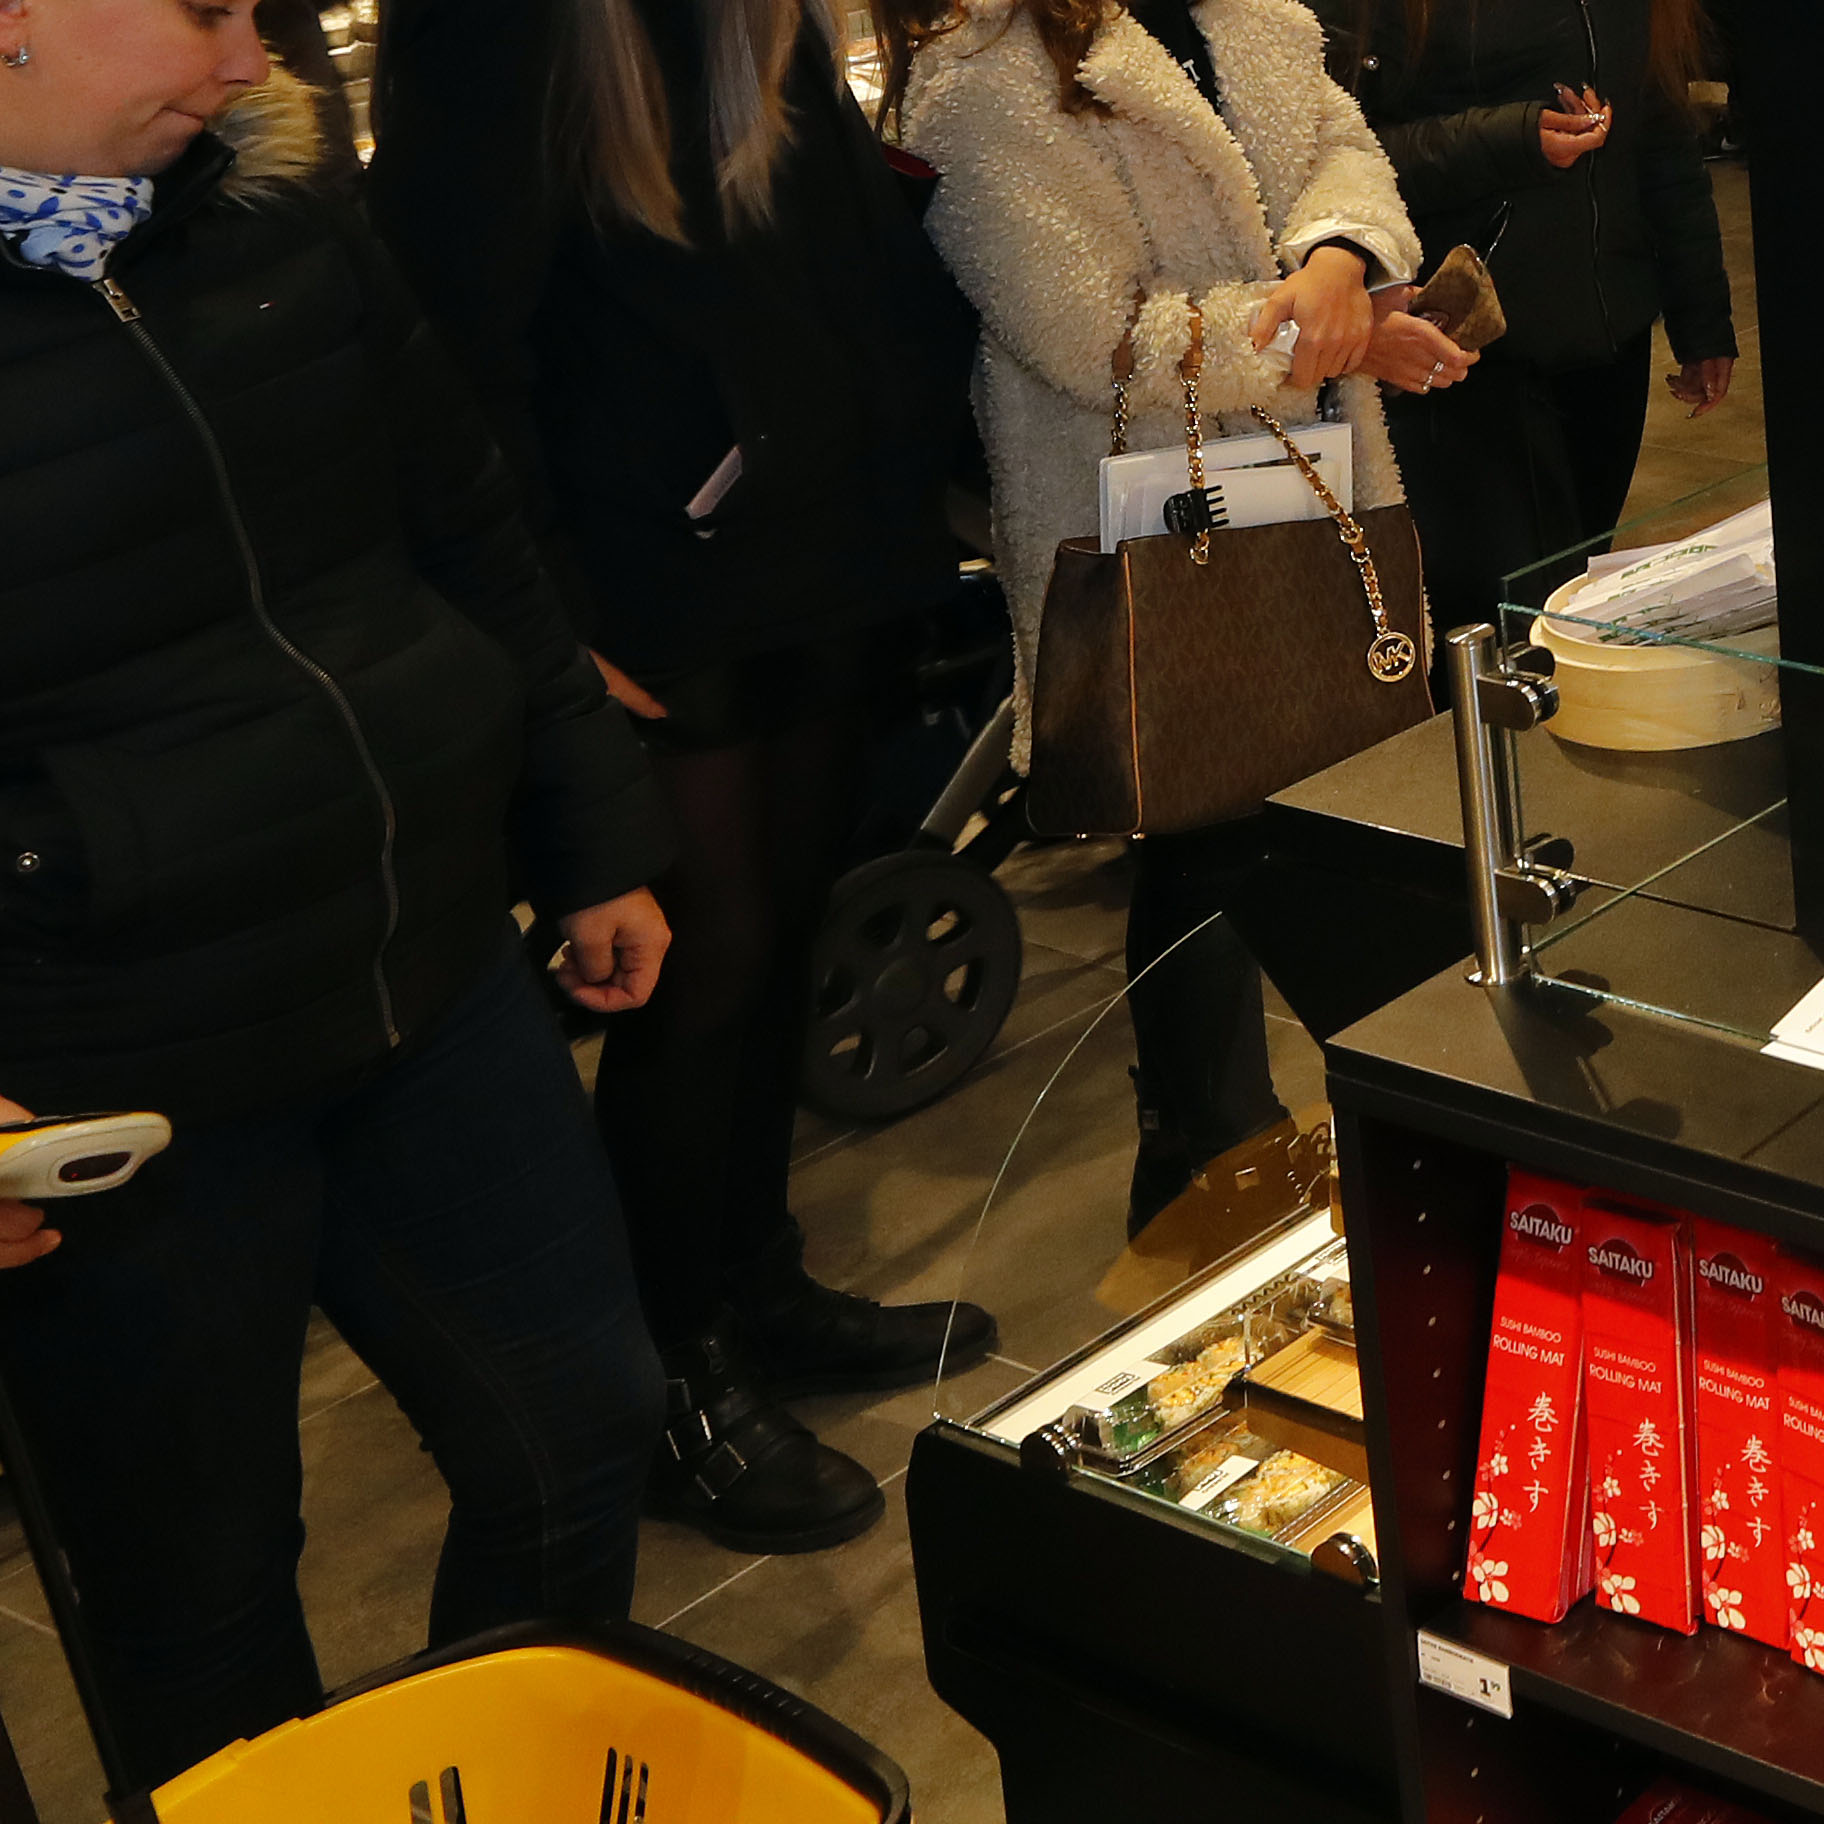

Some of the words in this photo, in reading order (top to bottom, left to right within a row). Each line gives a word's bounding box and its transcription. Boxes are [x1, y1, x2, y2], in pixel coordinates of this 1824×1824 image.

[1509, 1211, 1574, 1245] SAITAKU
[1587, 1246, 1654, 1279] SAITAKU
[1698, 1258, 1764, 1294] SAITAKU
[1499, 1315, 1522, 1332] SUSHI
[1522, 1322, 1562, 1344] BAMBOO
[1492, 1333, 1538, 1360] ROLLING
[1539, 1348, 1566, 1367] MAT
[1593, 1346, 1617, 1362] SUSHI
[1617, 1351, 1657, 1373] BAMBOO
[1589, 1363, 1636, 1389] ROLLING
[1637, 1377, 1663, 1394] MAT
[1703, 1359, 1725, 1377] SUSHI
[1725, 1367, 1765, 1389] BAMBOO
[1698, 1376, 1744, 1404] ROLLING
[1745, 1393, 1771, 1411] MAT
[1788, 1395, 1809, 1414] SUSHI
[1522, 1390, 1559, 1514] 巻きす
[1632, 1417, 1665, 1531] 巻きす
[1740, 1433, 1773, 1549] 巻きす
